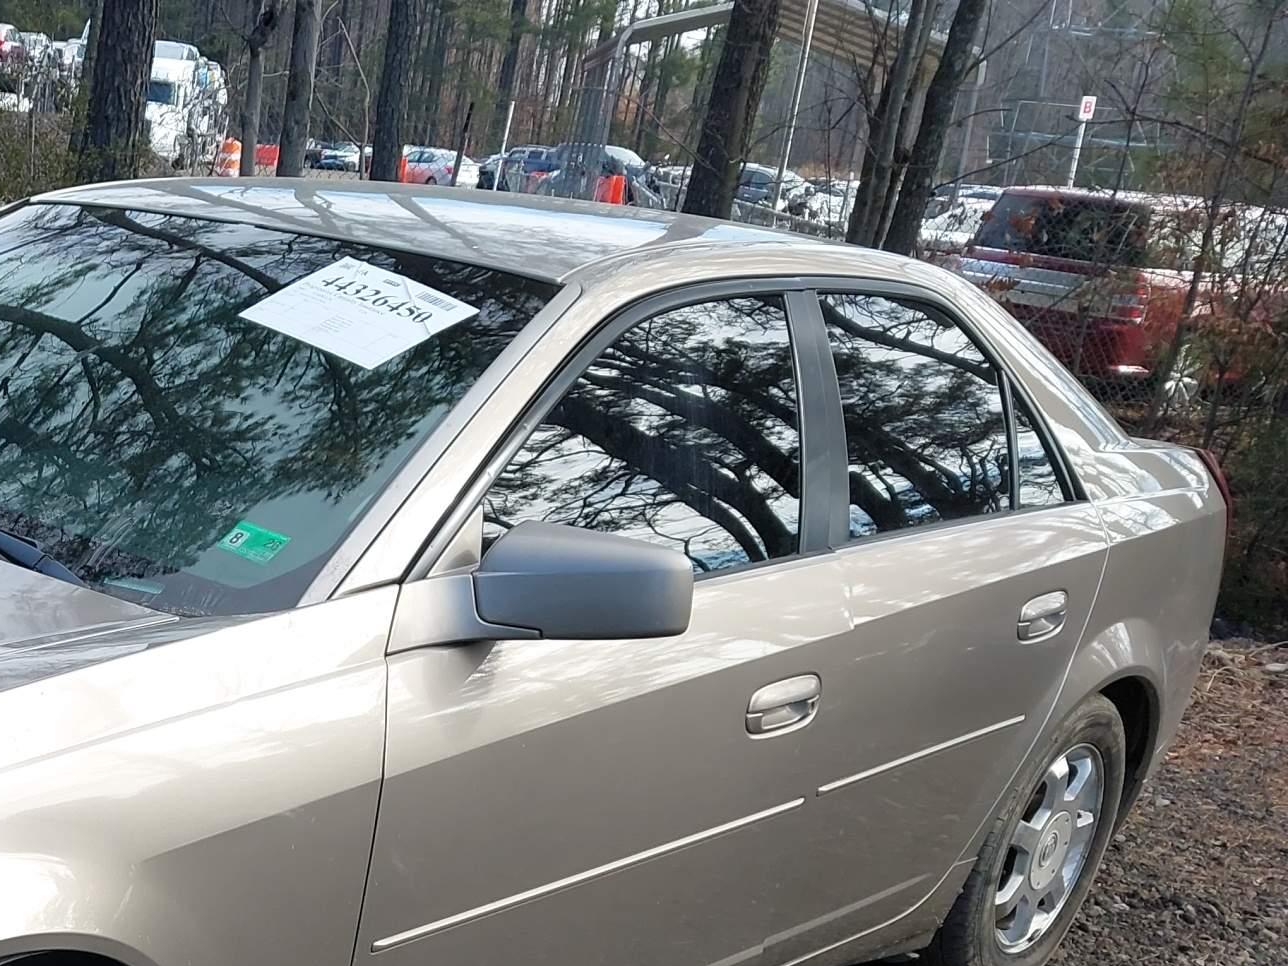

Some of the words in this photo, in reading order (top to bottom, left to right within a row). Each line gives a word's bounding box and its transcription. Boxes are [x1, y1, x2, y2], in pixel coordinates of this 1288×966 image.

[1083, 101, 1093, 113] B
[321, 276, 433, 323] 44326450
[228, 532, 244, 544] 8
